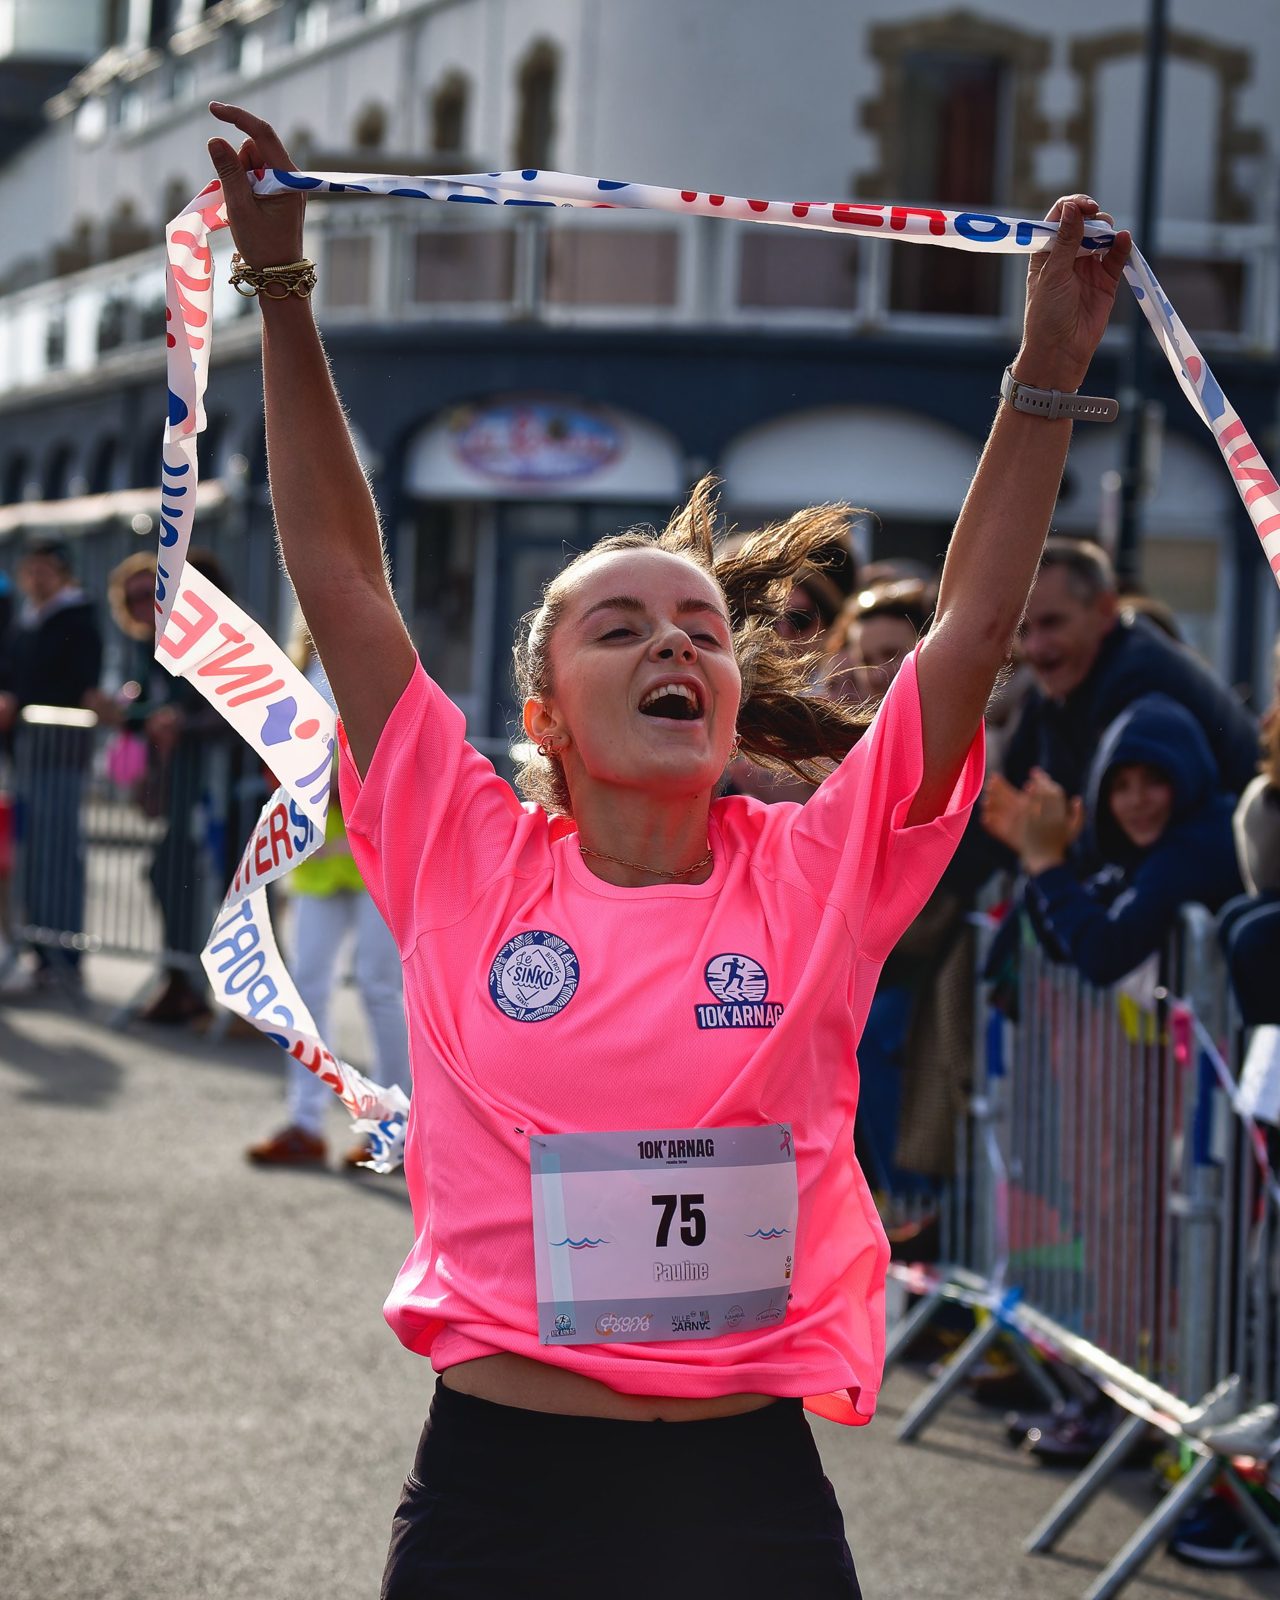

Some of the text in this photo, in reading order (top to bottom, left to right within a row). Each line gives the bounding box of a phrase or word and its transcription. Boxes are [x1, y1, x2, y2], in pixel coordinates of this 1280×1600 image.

[516, 951, 532, 967] Le
[545, 951, 561, 974] BISTROT
[513, 964, 554, 990] SINKO
[637, 1138, 715, 1160] 10K'ARNAG
[651, 1193, 707, 1248] 75
[653, 1261, 709, 1281] Pauline
[671, 1314, 691, 1323] VILLE
